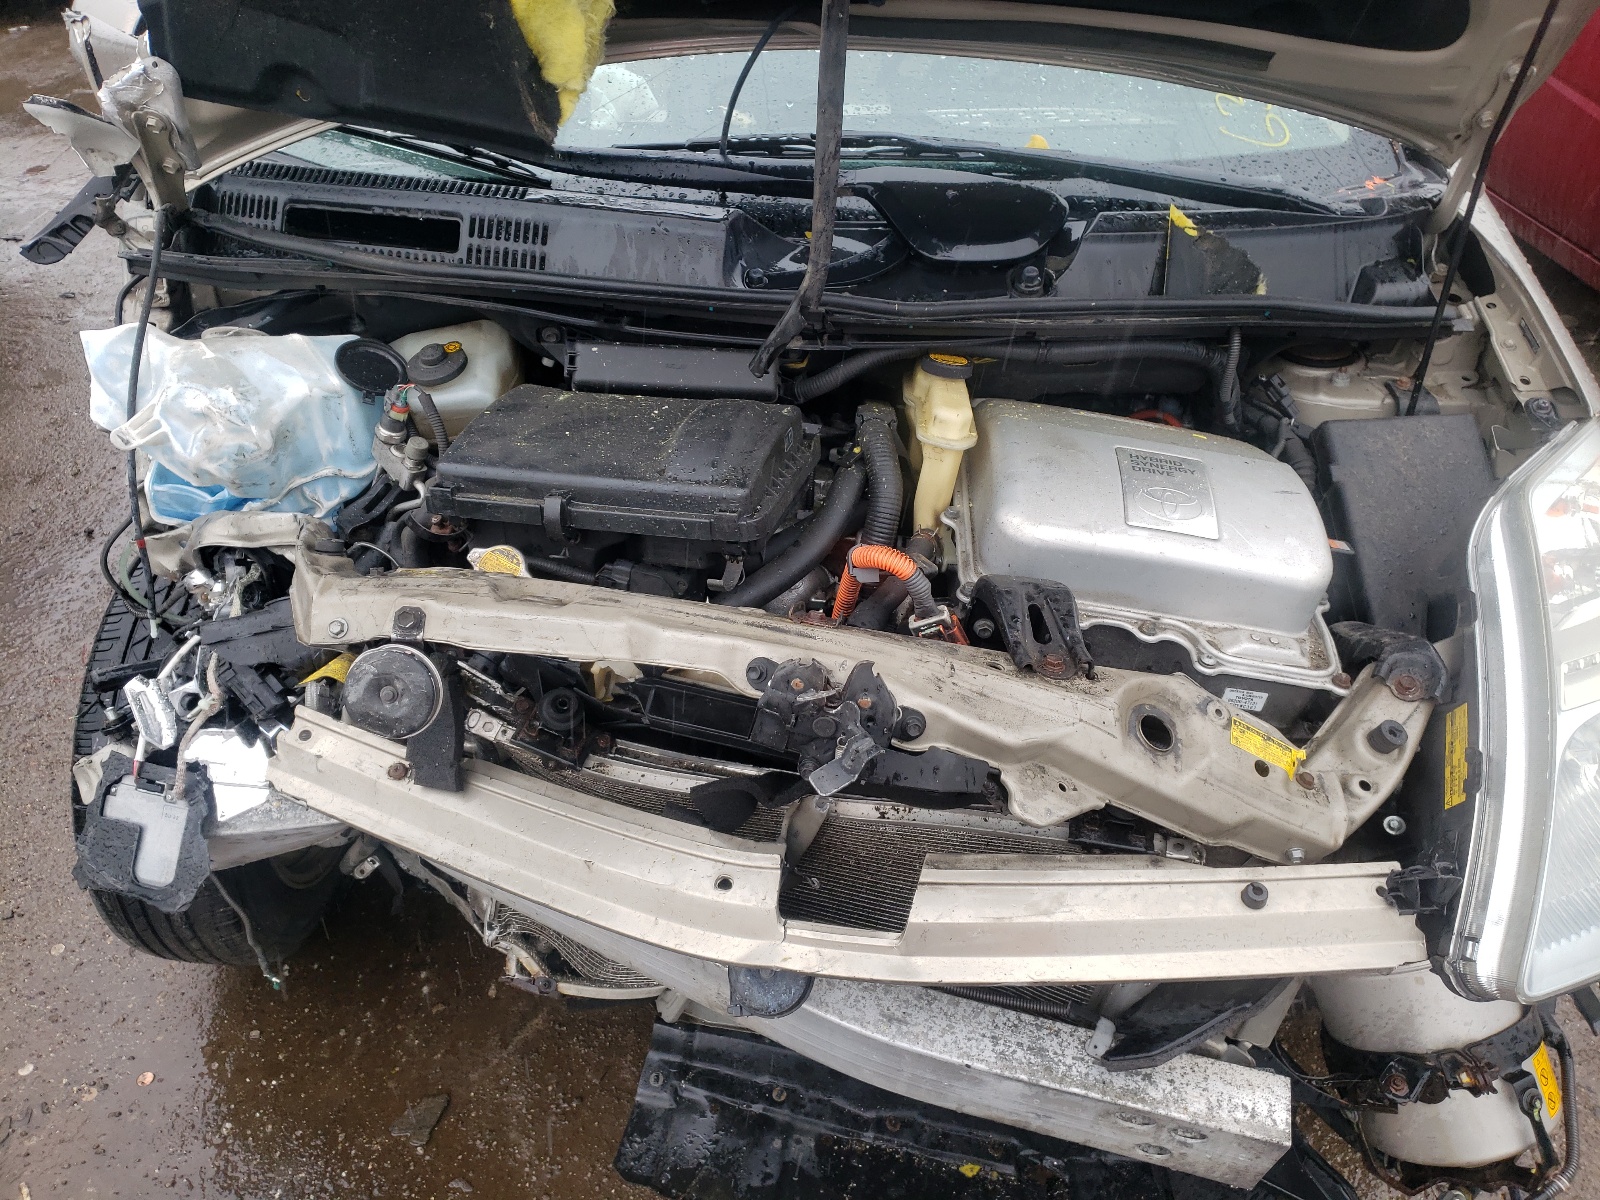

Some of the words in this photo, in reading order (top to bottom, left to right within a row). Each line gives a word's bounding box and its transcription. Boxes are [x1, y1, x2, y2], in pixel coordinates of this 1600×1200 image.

[1129, 453, 1183, 467] HYBRID
[1130, 459, 1197, 475] SYNERGY
[1131, 465, 1176, 478] DRIVE
